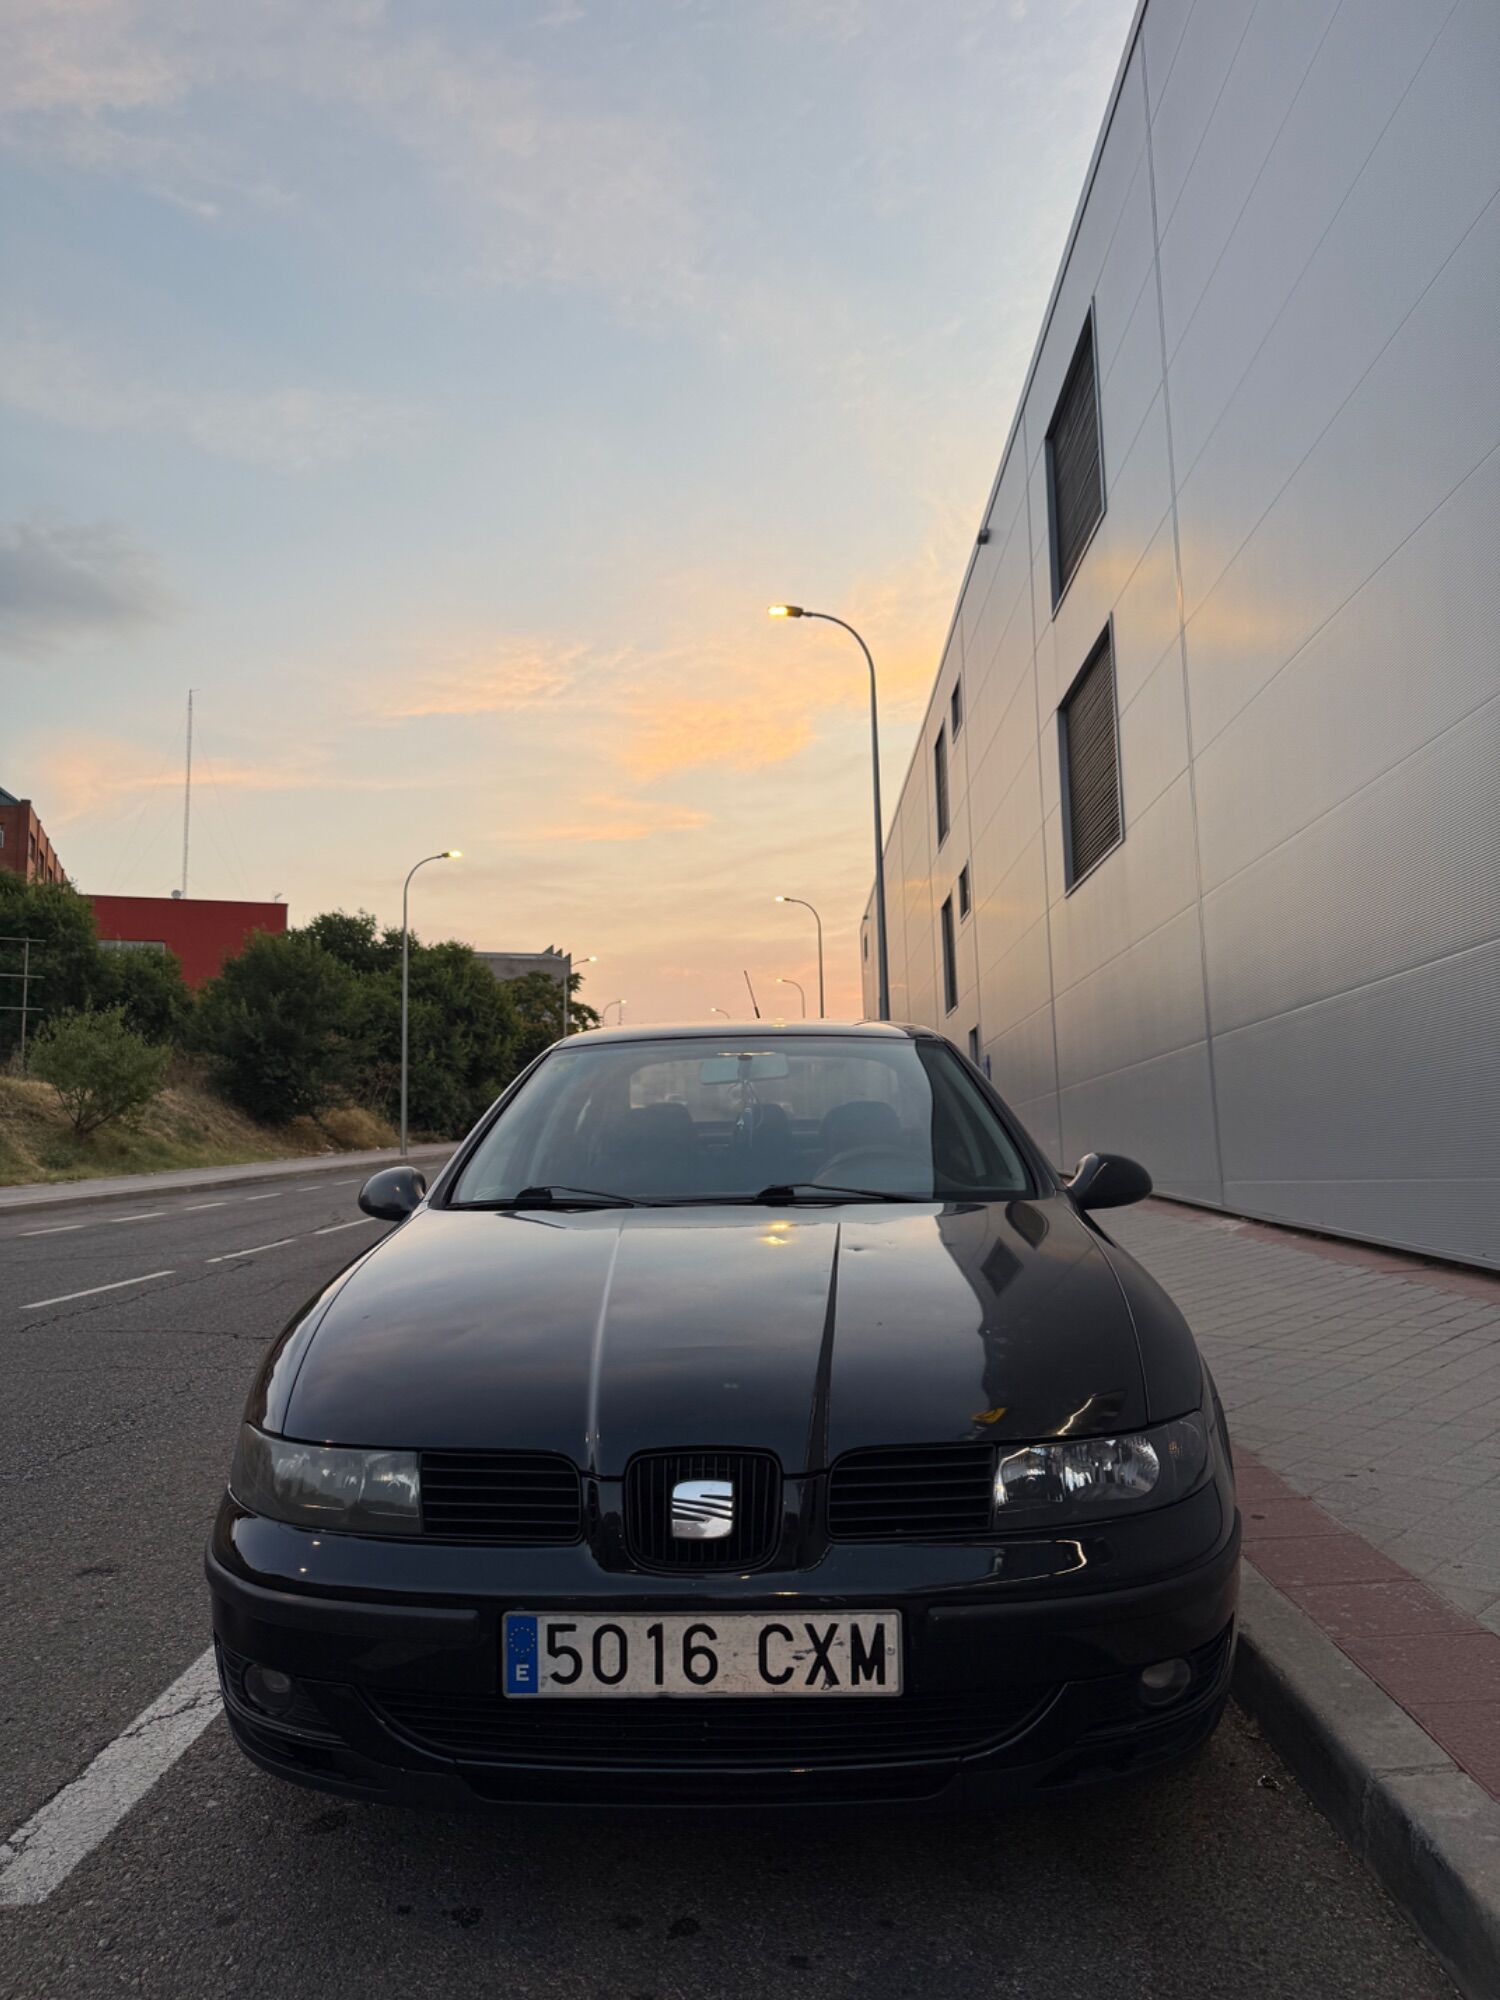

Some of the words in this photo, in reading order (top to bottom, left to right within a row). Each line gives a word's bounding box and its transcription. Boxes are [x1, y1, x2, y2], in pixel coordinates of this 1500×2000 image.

[515, 1664, 529, 1682] E
[546, 1623, 718, 1685] 5016
[758, 1623, 886, 1686] CXM
